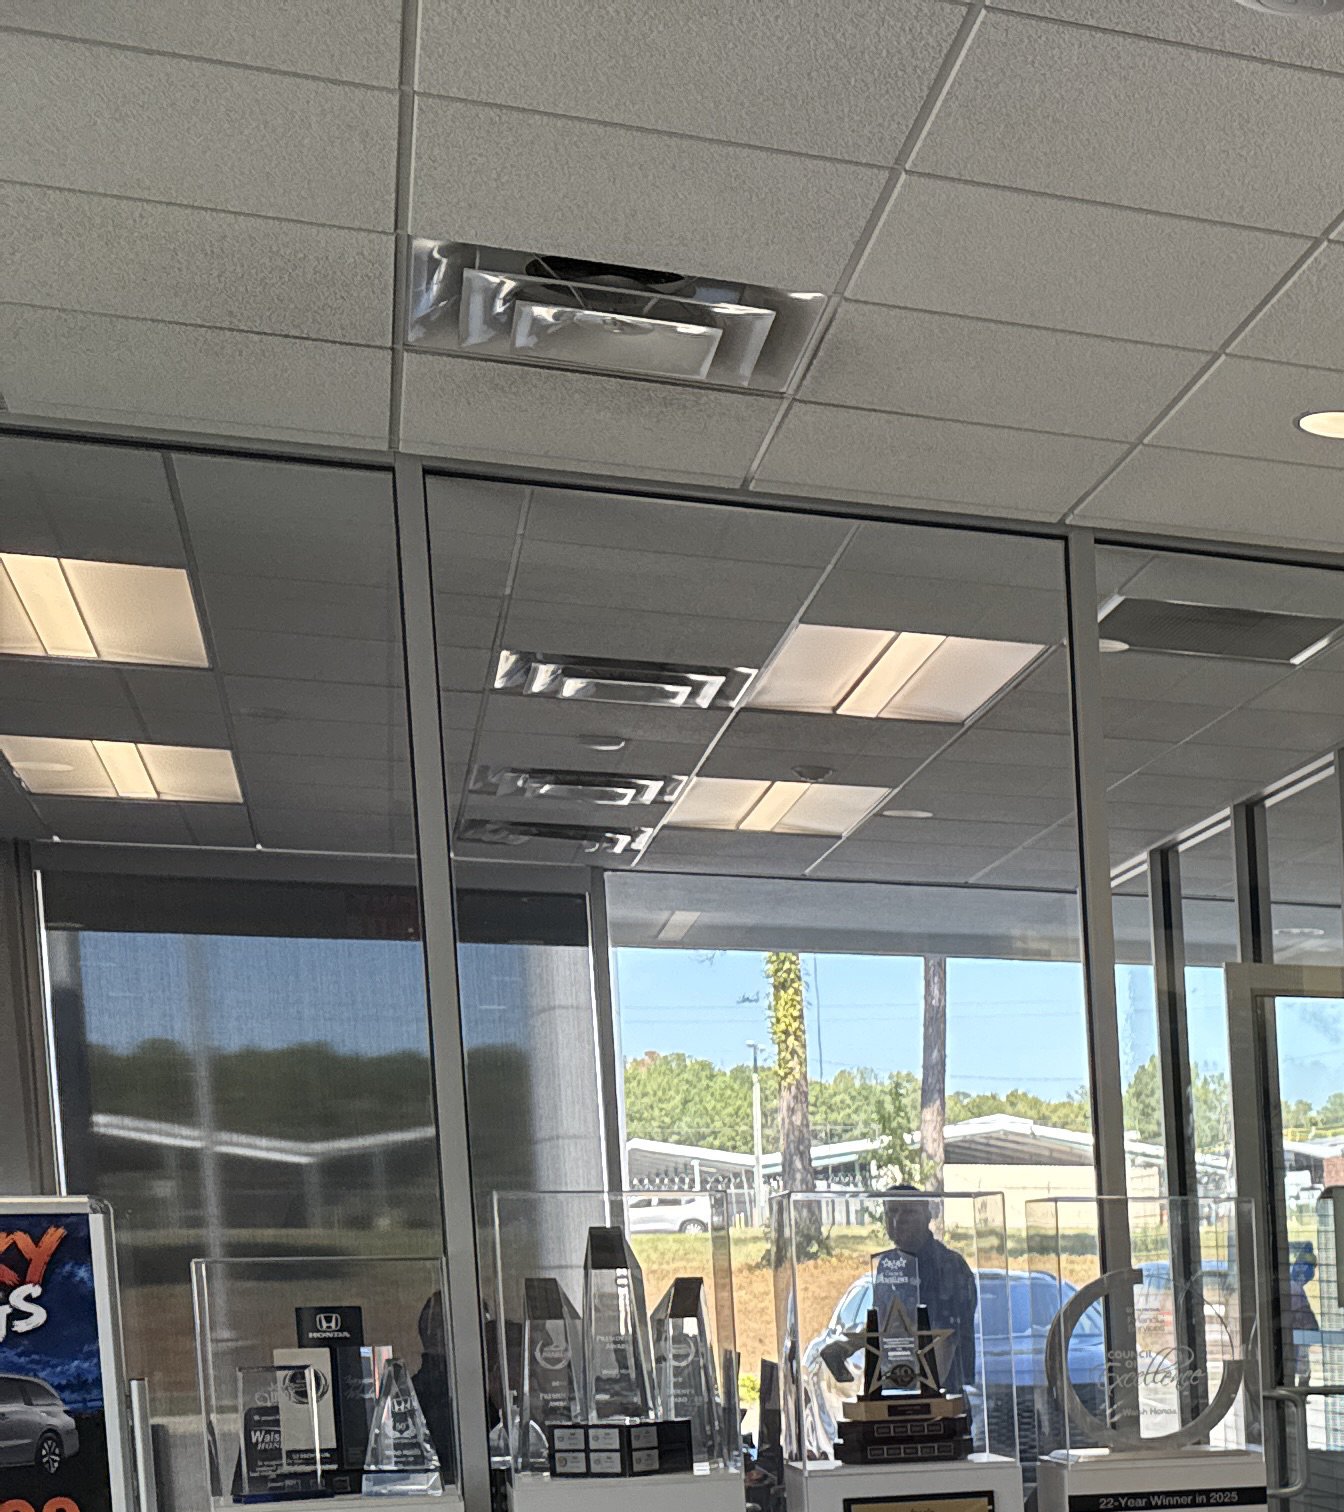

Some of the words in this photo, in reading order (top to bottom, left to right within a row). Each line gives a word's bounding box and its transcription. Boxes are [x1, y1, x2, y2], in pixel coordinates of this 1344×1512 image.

[308, 1331, 351, 1340] HONDA
[1107, 1349, 1153, 1360] COUNCIL
[251, 1430, 280, 1443] Wals
[1099, 1495, 1147, 1509] 22-Year
[1149, 1493, 1194, 1506] Winner
[1196, 1493, 1206, 1503] in
[1210, 1492, 1238, 1502] 2025
